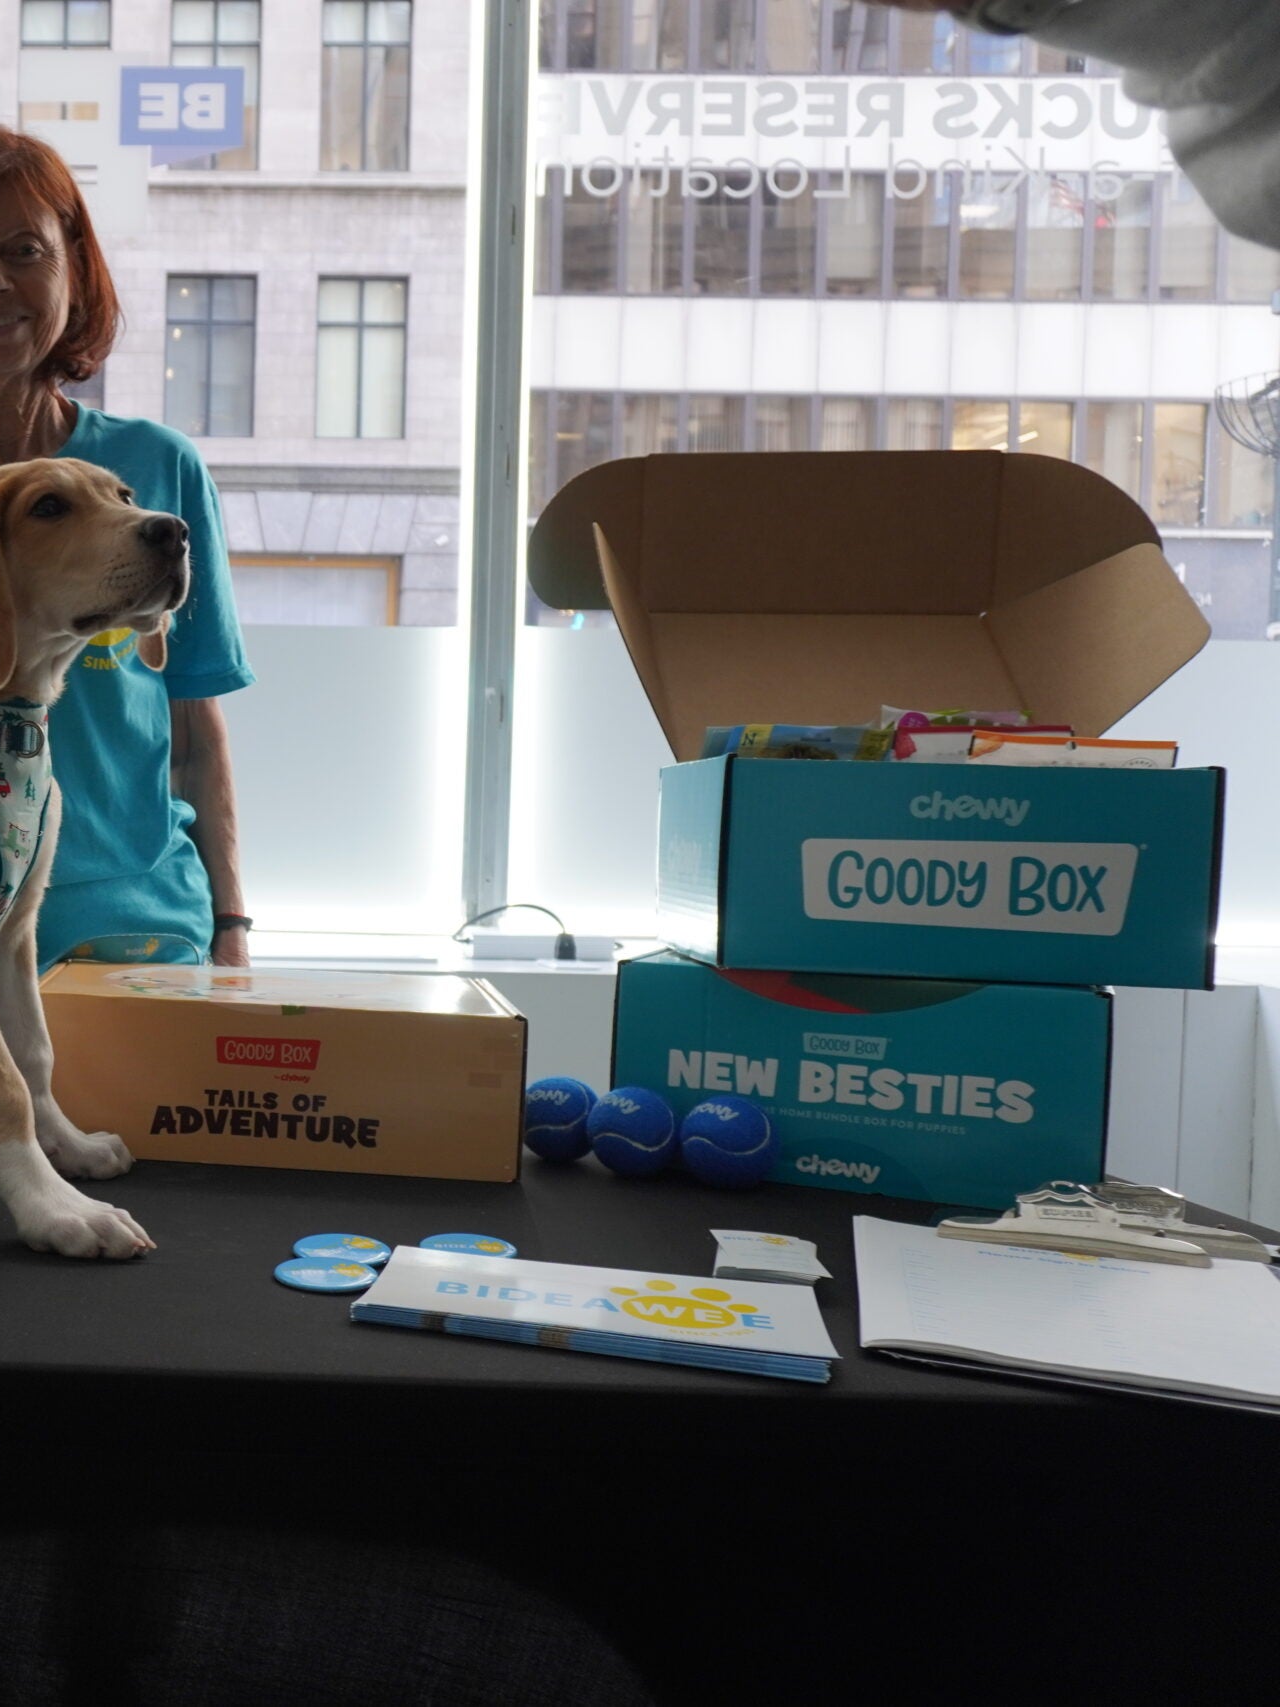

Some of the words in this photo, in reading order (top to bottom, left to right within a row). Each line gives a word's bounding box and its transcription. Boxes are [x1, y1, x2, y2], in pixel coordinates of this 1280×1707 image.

[909, 790, 1031, 827] chewy
[827, 850, 988, 910] GOODY
[1008, 856, 1109, 917] BOX
[223, 1039, 276, 1062] GOODY
[280, 1043, 313, 1065] BOX
[809, 1035, 851, 1053] GOODY
[854, 1038, 882, 1056] BOX
[204, 1088, 279, 1111] TAILS
[292, 1093, 327, 1113] OF
[667, 1048, 781, 1098] NEW
[797, 1058, 1036, 1125] BESTIES
[149, 1105, 381, 1150] ADVENTURE
[795, 1153, 882, 1185] chewy
[436, 1279, 776, 1331] BIDEAWEE
